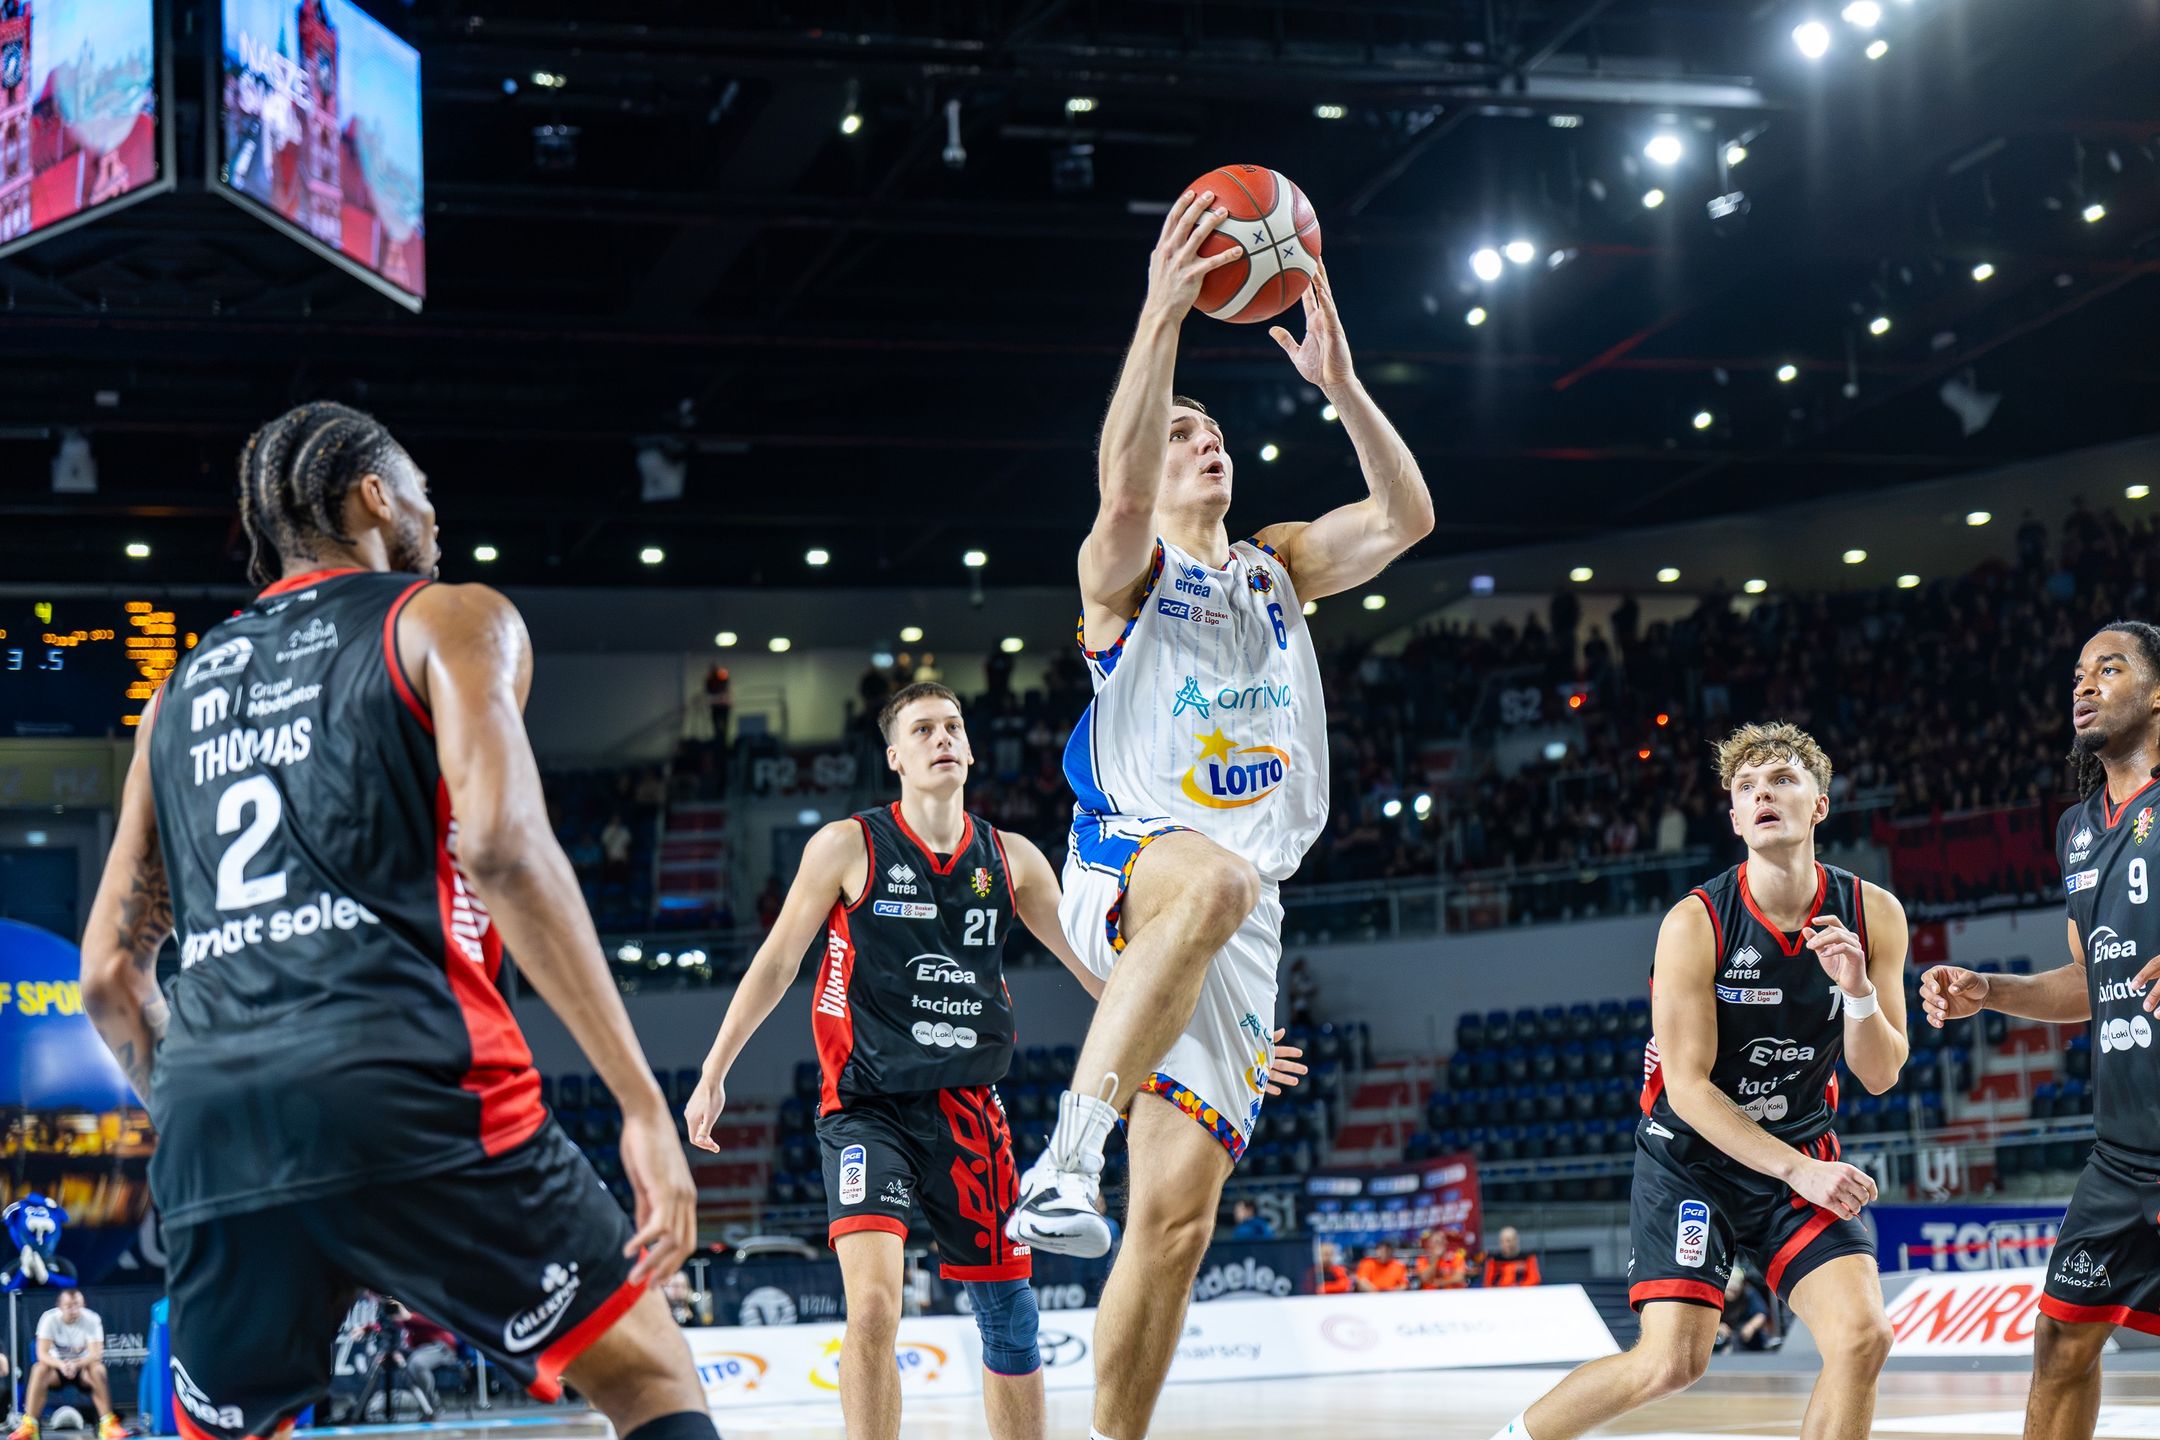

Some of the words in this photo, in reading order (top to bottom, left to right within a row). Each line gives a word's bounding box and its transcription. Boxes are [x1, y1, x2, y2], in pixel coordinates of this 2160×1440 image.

[1174, 577, 1211, 599] errea
[1160, 602, 1187, 617] PGE
[1205, 609, 1229, 620] Basket
[1204, 617, 1220, 626] Liga
[1266, 603, 1288, 651] 6
[190, 716, 313, 787] THOMAS
[1208, 757, 1283, 797] LOTTO
[215, 773, 288, 912] 2
[2127, 857, 2149, 905] 9
[887, 882, 918, 896] errea
[878, 904, 900, 914] PGE
[914, 904, 934, 912] Basket
[962, 907, 999, 947] 21
[2094, 939, 2137, 964] Enea
[916, 963, 977, 984] Enea
[1724, 968, 1761, 980] errea
[2110, 1030, 2129, 1040] Loki
[2134, 1027, 2149, 1037] Koki
[1767, 1102, 1784, 1111] Koki
[1683, 1207, 1706, 1217] PGE
[1679, 1247, 1703, 1256] Basket
[1683, 1254, 1698, 1262] Liga
[2053, 1273, 2107, 1289] BYDGOSZCZ
